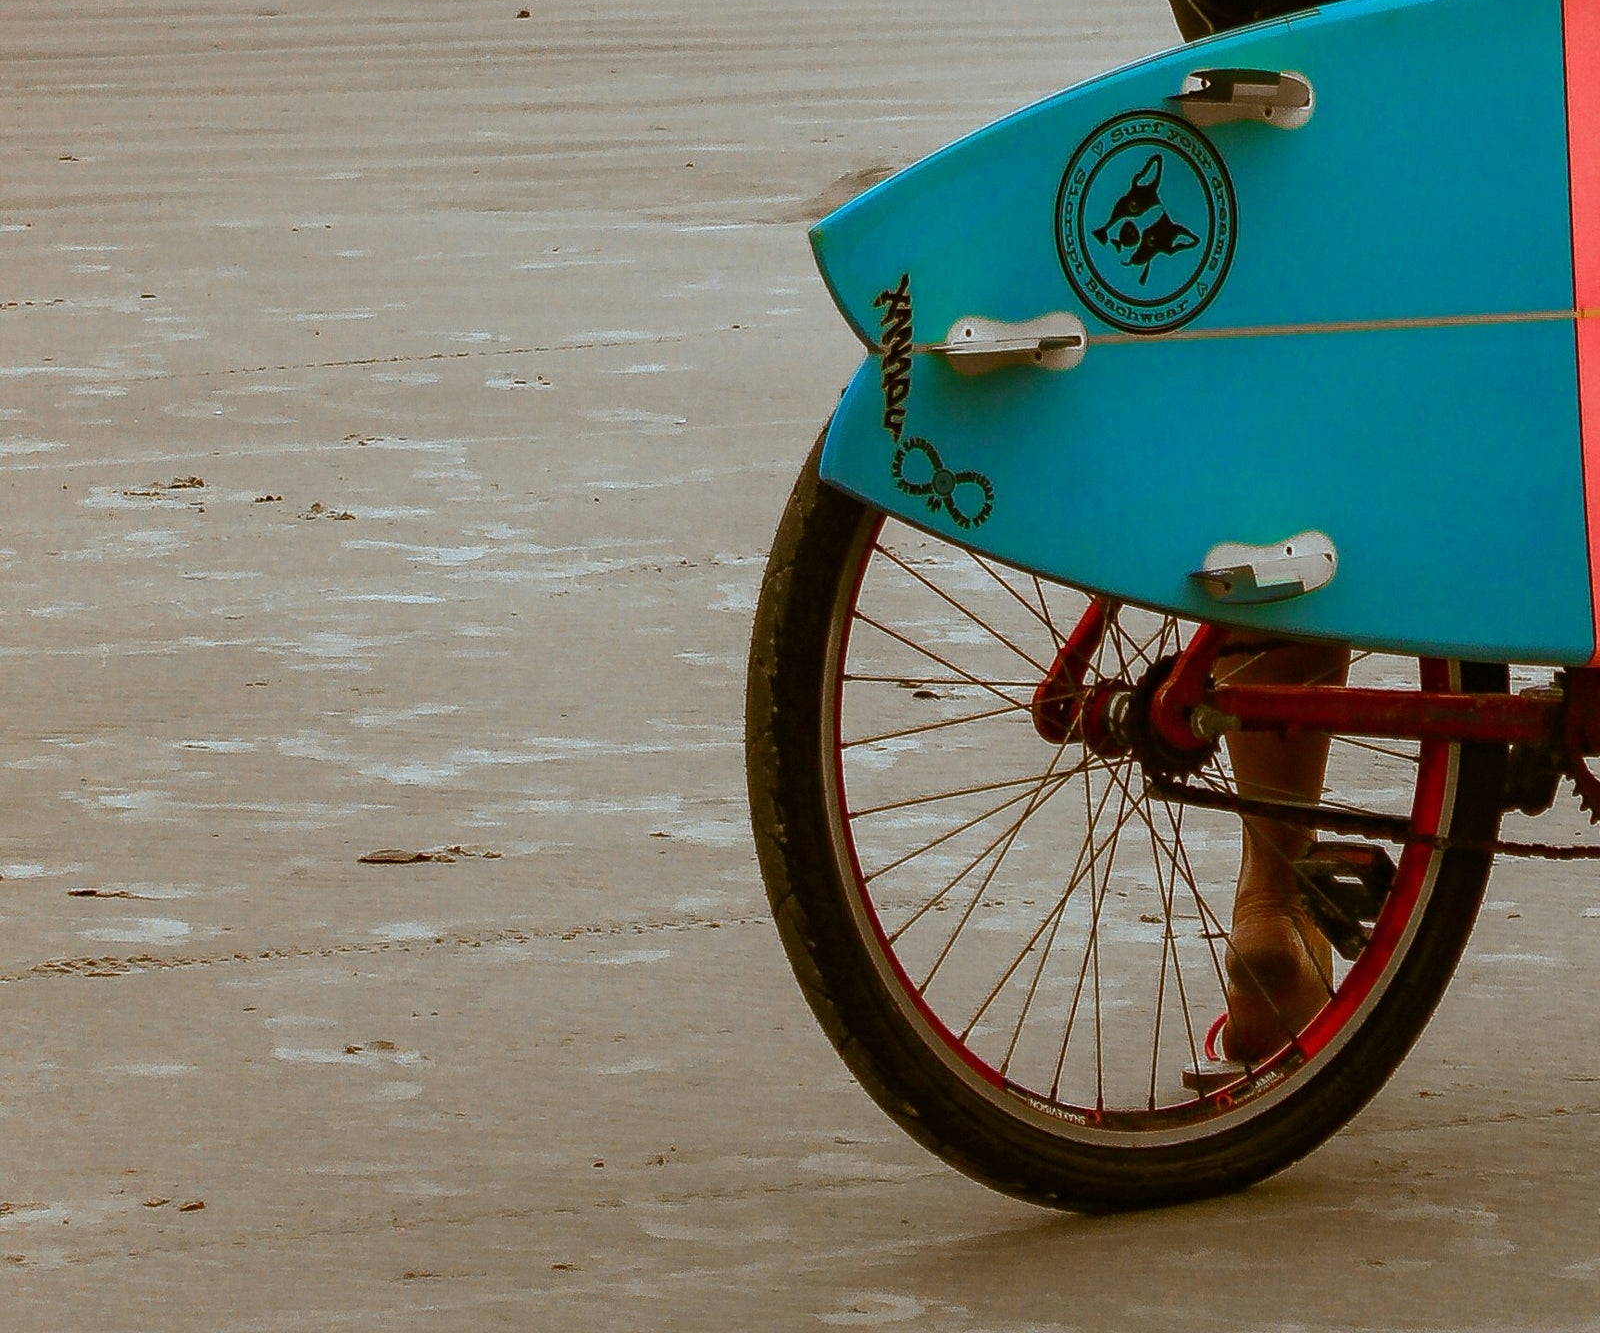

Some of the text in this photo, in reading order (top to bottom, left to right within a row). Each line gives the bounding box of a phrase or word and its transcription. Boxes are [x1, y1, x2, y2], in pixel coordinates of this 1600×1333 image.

[1110, 121, 1229, 271] Surf your dreams
[1084, 277, 1190, 323] Beachwear
